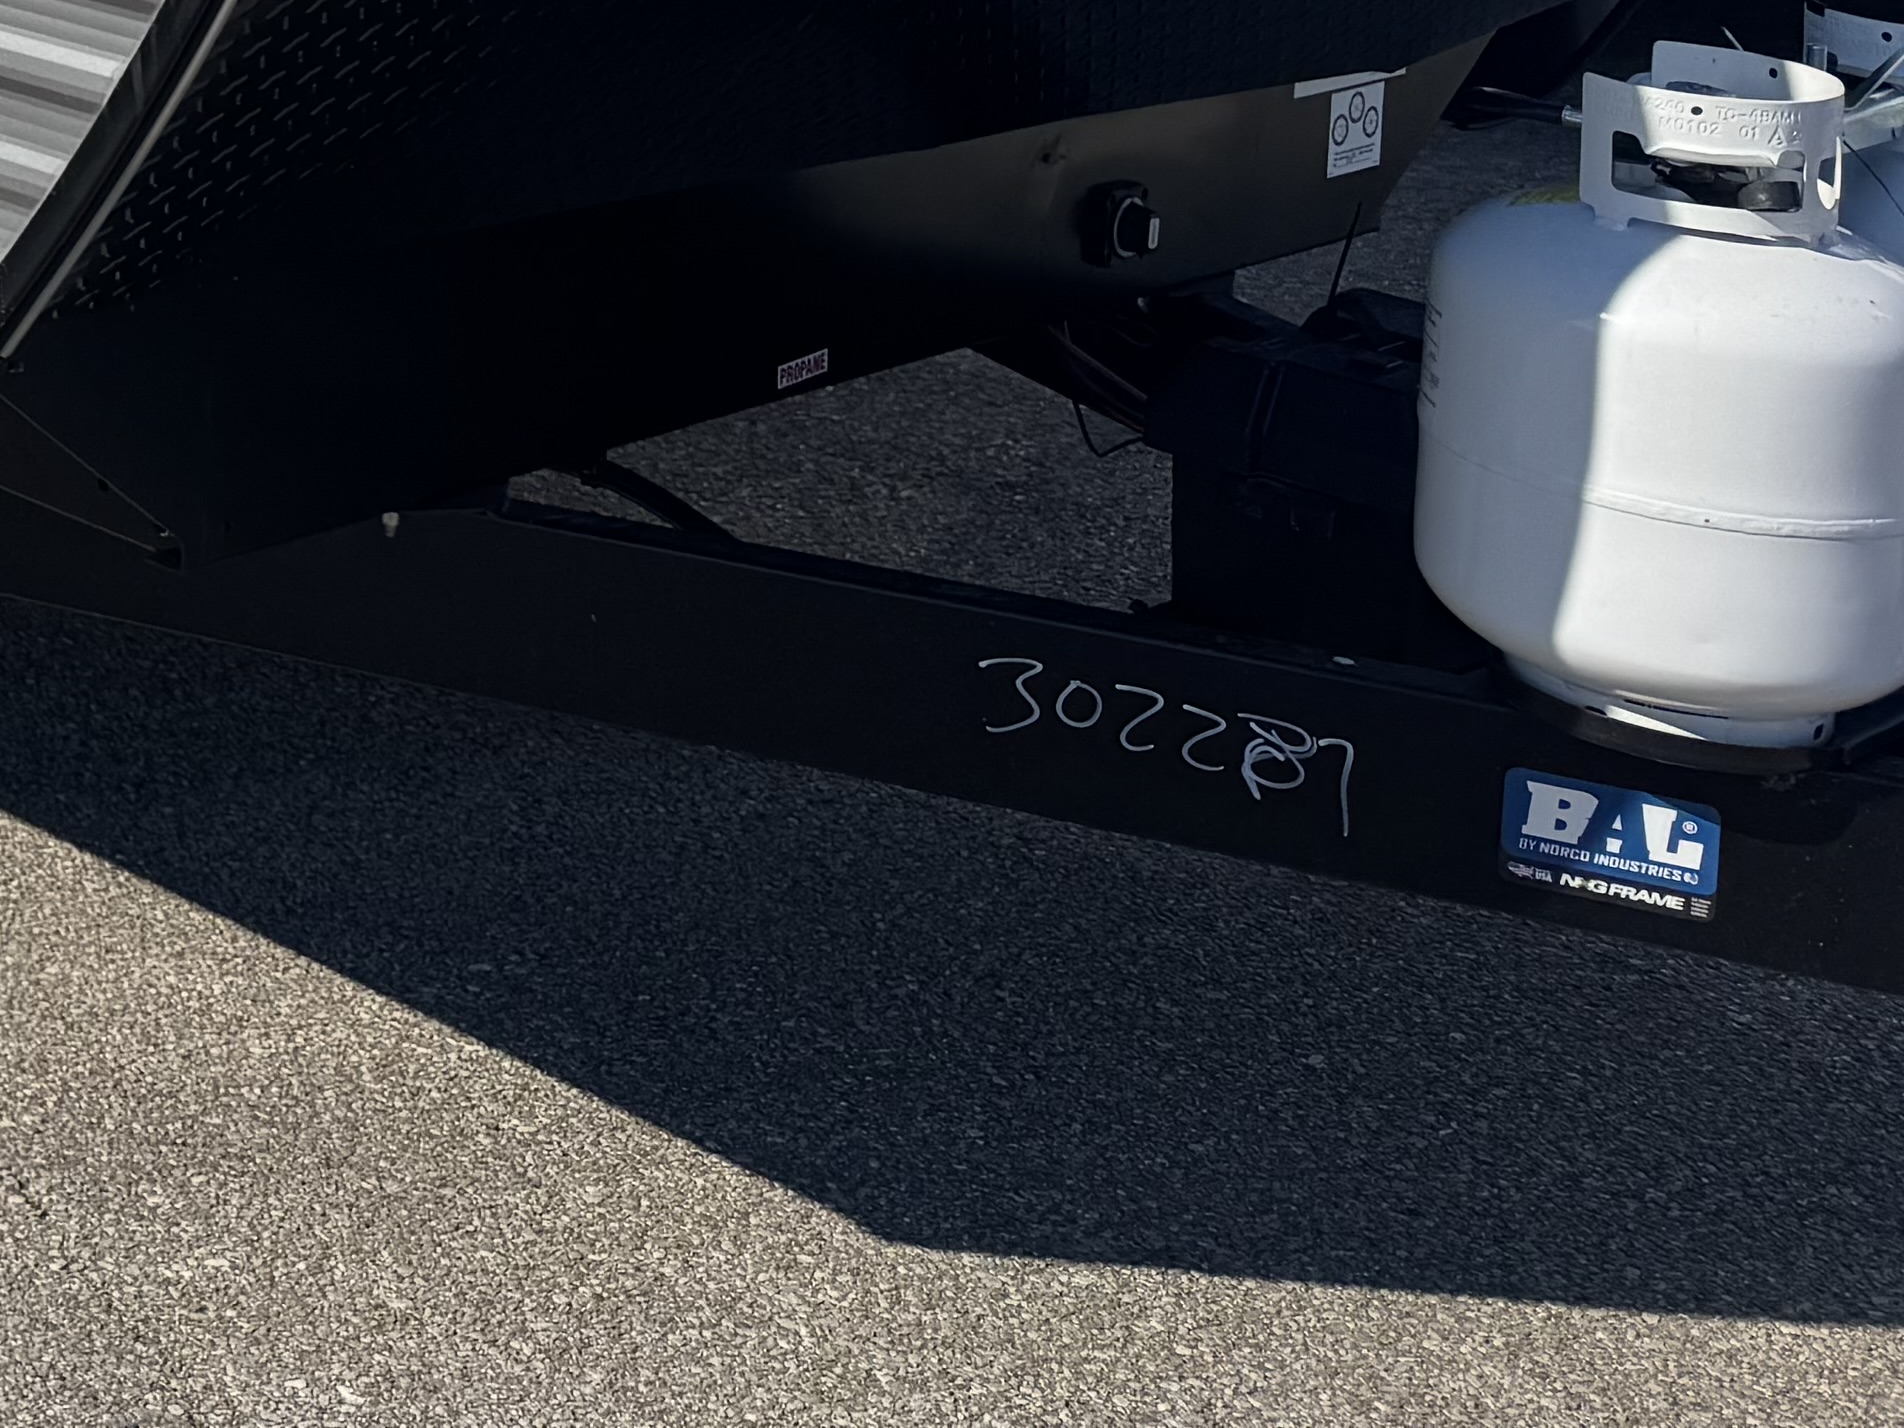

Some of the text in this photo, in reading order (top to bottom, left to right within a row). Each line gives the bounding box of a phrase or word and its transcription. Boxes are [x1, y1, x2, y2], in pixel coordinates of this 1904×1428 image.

[779, 350, 826, 385] PROPANE
[1519, 837, 1683, 882] BY NORCO INDUSTRIES
[1607, 882, 1686, 911] FRAME
